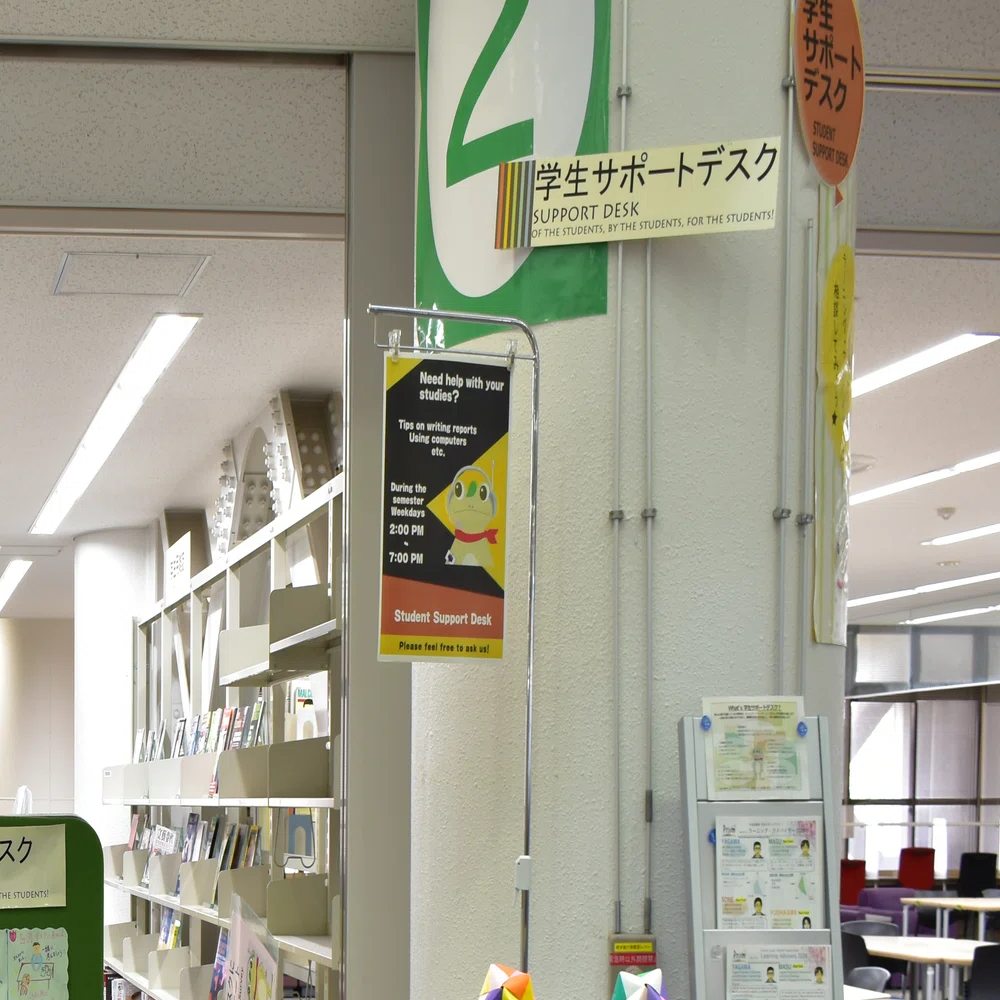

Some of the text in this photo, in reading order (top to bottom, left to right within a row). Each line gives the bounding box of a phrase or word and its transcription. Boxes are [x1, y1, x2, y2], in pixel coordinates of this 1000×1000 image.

[803, 28, 861, 80] サポート
[804, 68, 847, 113] デスク
[813, 120, 836, 142] STUDENT
[812, 141, 849, 167] SUPPORT DESK
[535, 142, 778, 201] 学生サポートデスク
[533, 201, 640, 225] SUPPORT DESK
[531, 209, 774, 238] OF THE STUDENTS, BY THE STUDENTS, FOR THE STUDENTS!
[420, 371, 505, 393] Need help with your
[419, 387, 460, 403] studies?
[398, 419, 477, 436] Tips on writing reports
[408, 432, 467, 448] Using computers
[431, 447, 446, 457] etc.
[390, 482, 427, 494] During the
[392, 496, 424, 505] semester
[390, 507, 425, 519] Weekdays
[389, 524, 424, 536] 2:00 PM
[389, 551, 423, 564] 7:00 PM
[394, 609, 492, 626] Student Support Desk
[399, 641, 490, 653] Please feel free to ask us!
[13, 889, 49, 899] STUDENTS!
